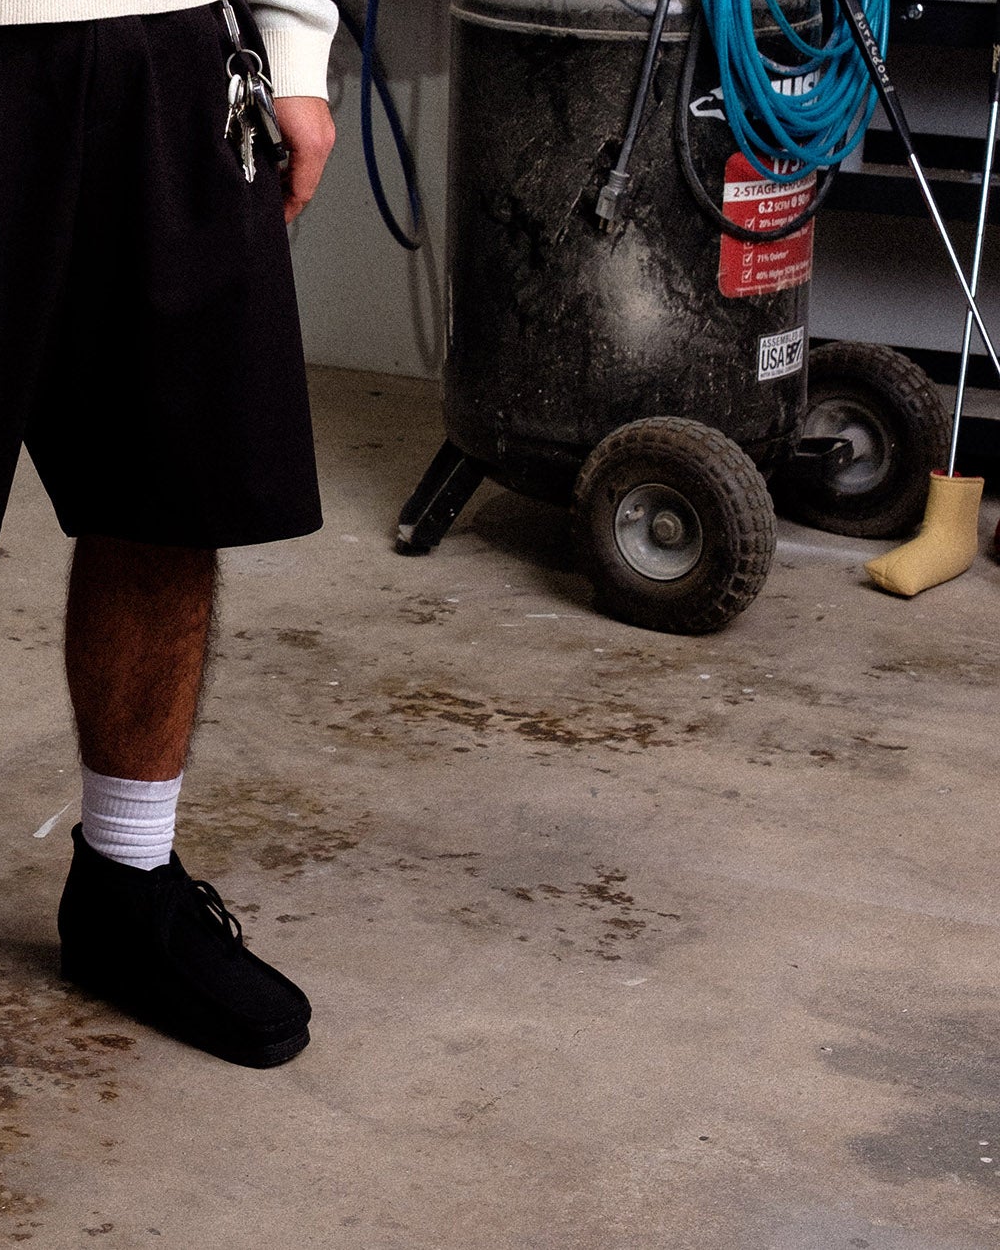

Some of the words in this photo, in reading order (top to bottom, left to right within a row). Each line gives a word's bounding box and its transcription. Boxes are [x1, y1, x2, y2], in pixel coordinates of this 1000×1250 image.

[734, 183, 777, 198] 2-STAGE
[758, 200, 774, 214] 6.2
[762, 331, 798, 348] ASSEMBLED
[761, 346, 784, 371] USA
